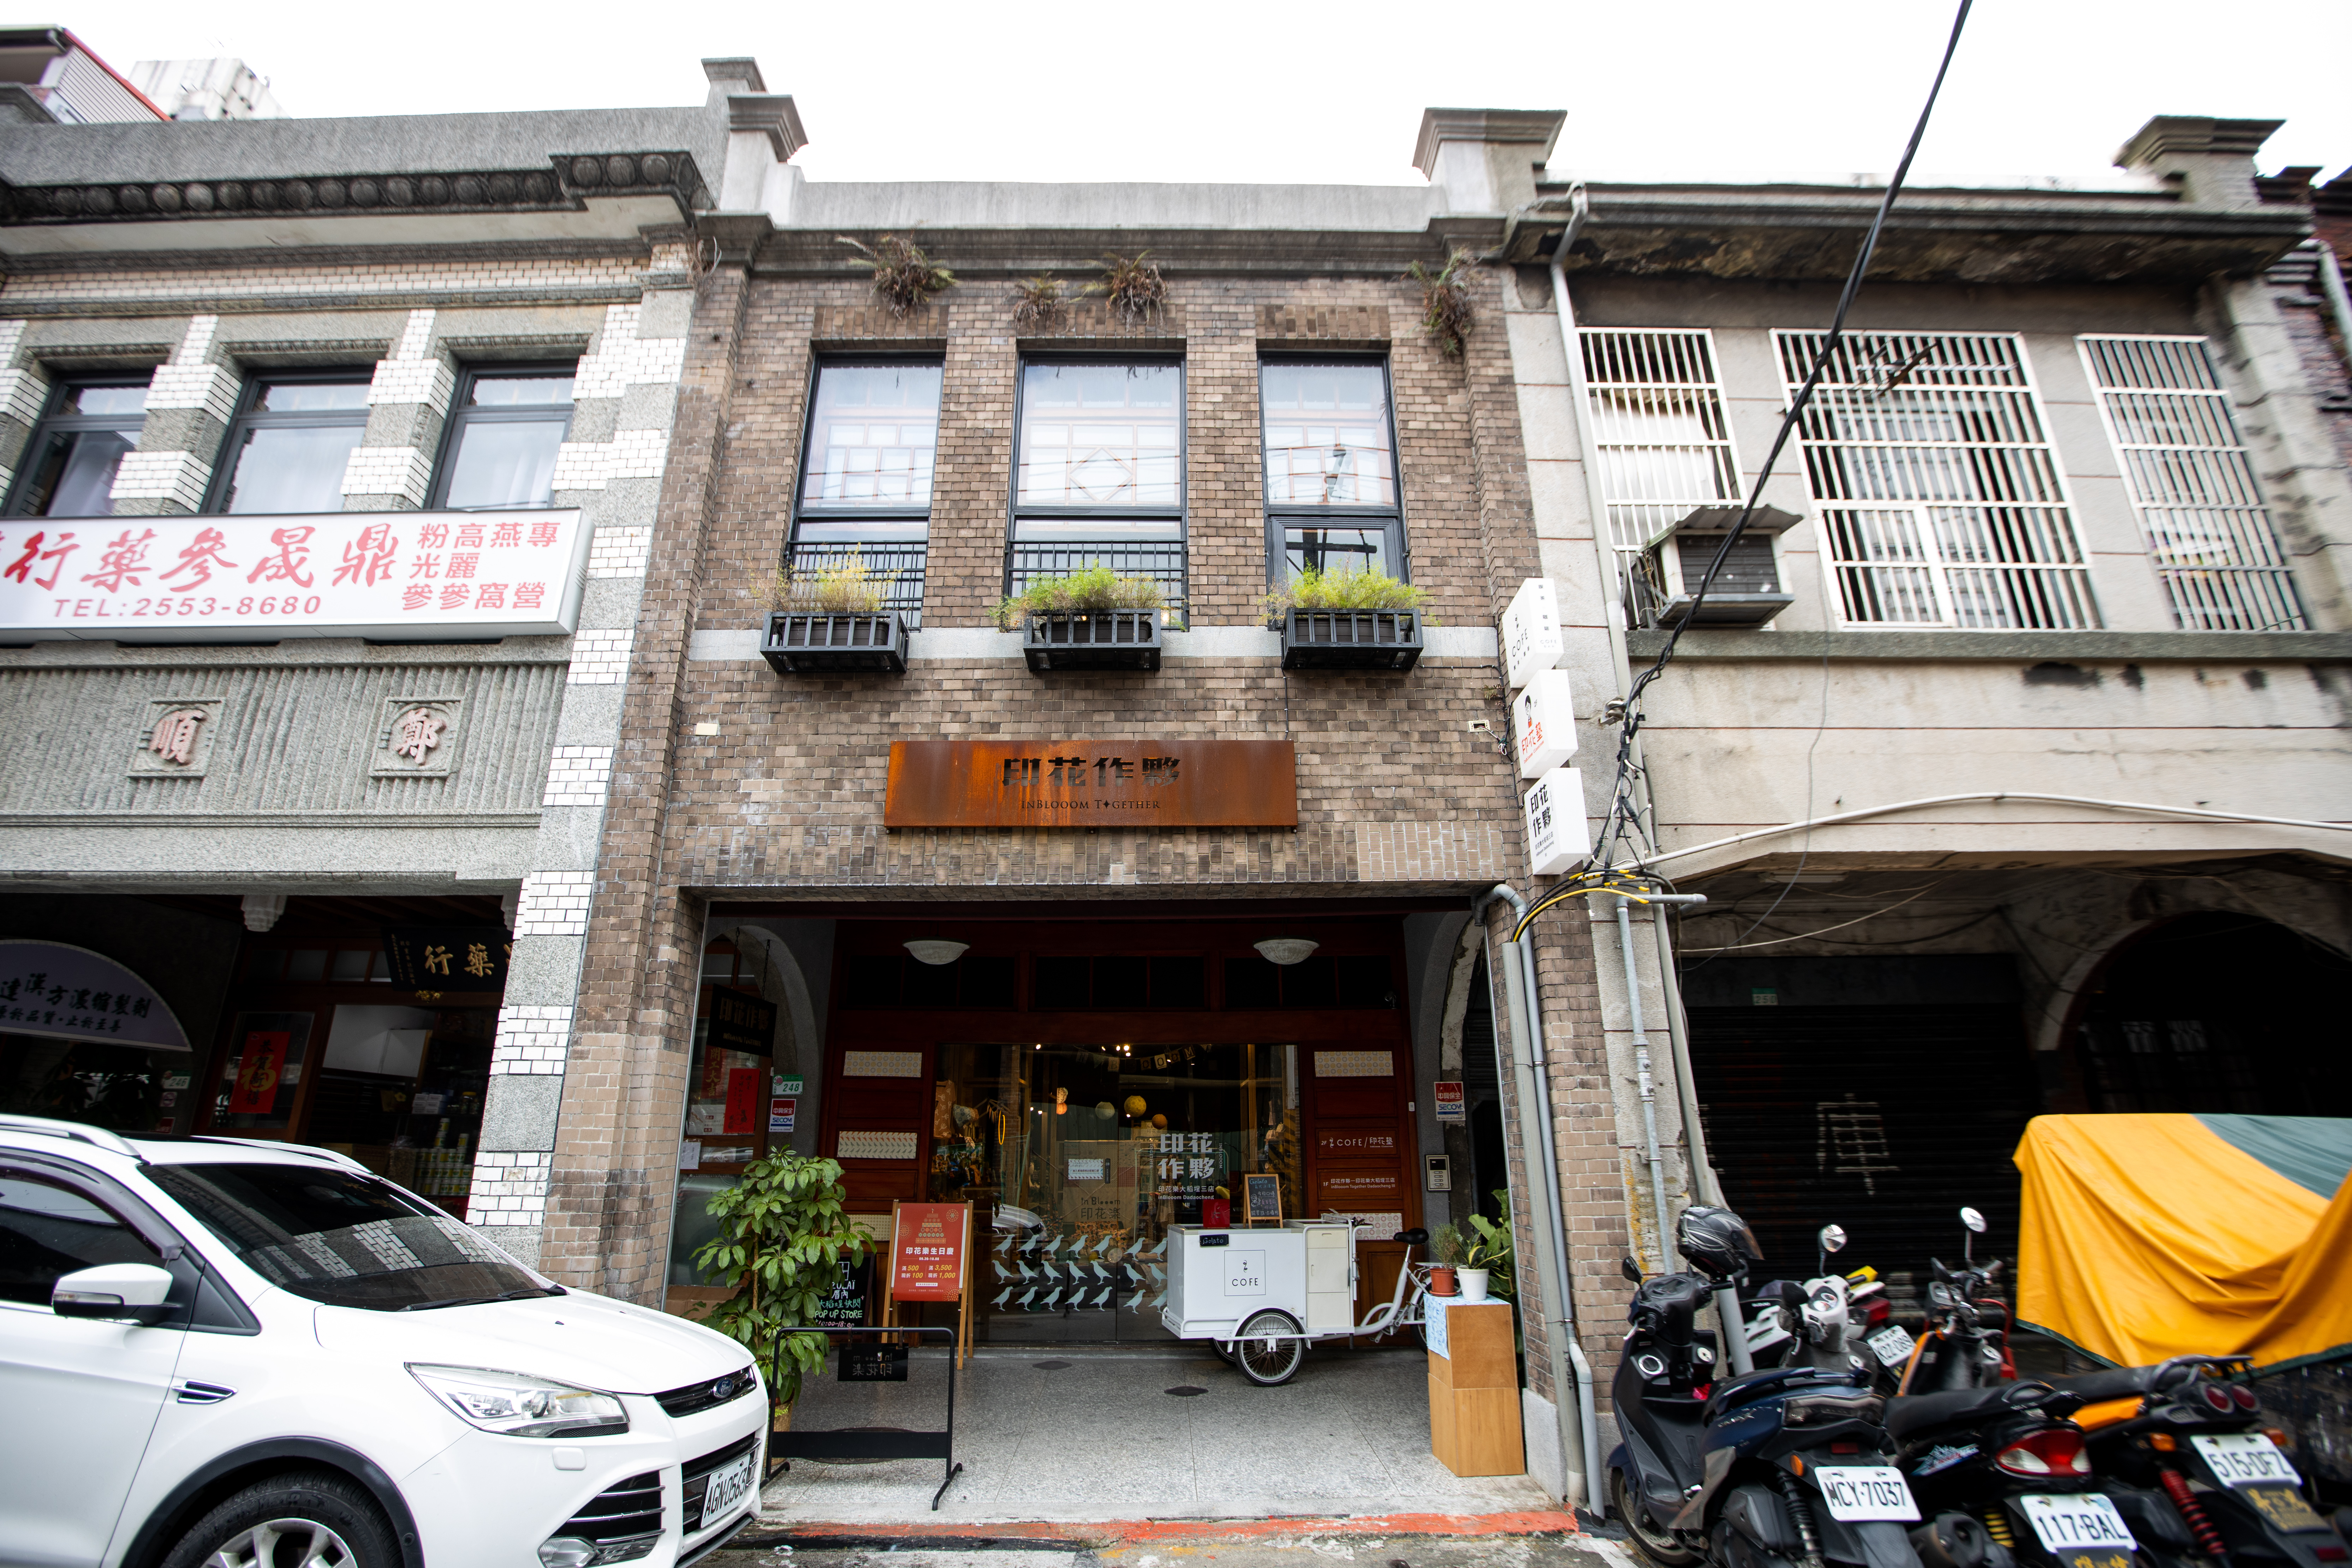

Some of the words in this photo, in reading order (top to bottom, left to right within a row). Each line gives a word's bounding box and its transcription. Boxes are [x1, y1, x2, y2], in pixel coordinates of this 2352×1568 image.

[1512, 628, 1528, 657] COFE
[1522, 722, 1543, 755] 印花塾
[1002, 756, 1181, 787] 印花作夥
[719, 997, 770, 1031] 印花作夥
[170, 1078, 187, 1087] 246
[705, 1047, 721, 1097] 開工大吉
[782, 1083, 800, 1092] 248
[1160, 1132, 1213, 1153] 印花
[1157, 1157, 1215, 1179] 作夥
[906, 1247, 954, 1255] 印花樂生日慶
[1232, 1278, 1258, 1286] COFE
[814, 1310, 828, 1319] POP
[829, 1309, 839, 1318] UP
[840, 1310, 863, 1319] STORE
[720, 1381, 732, 1394] Ford
